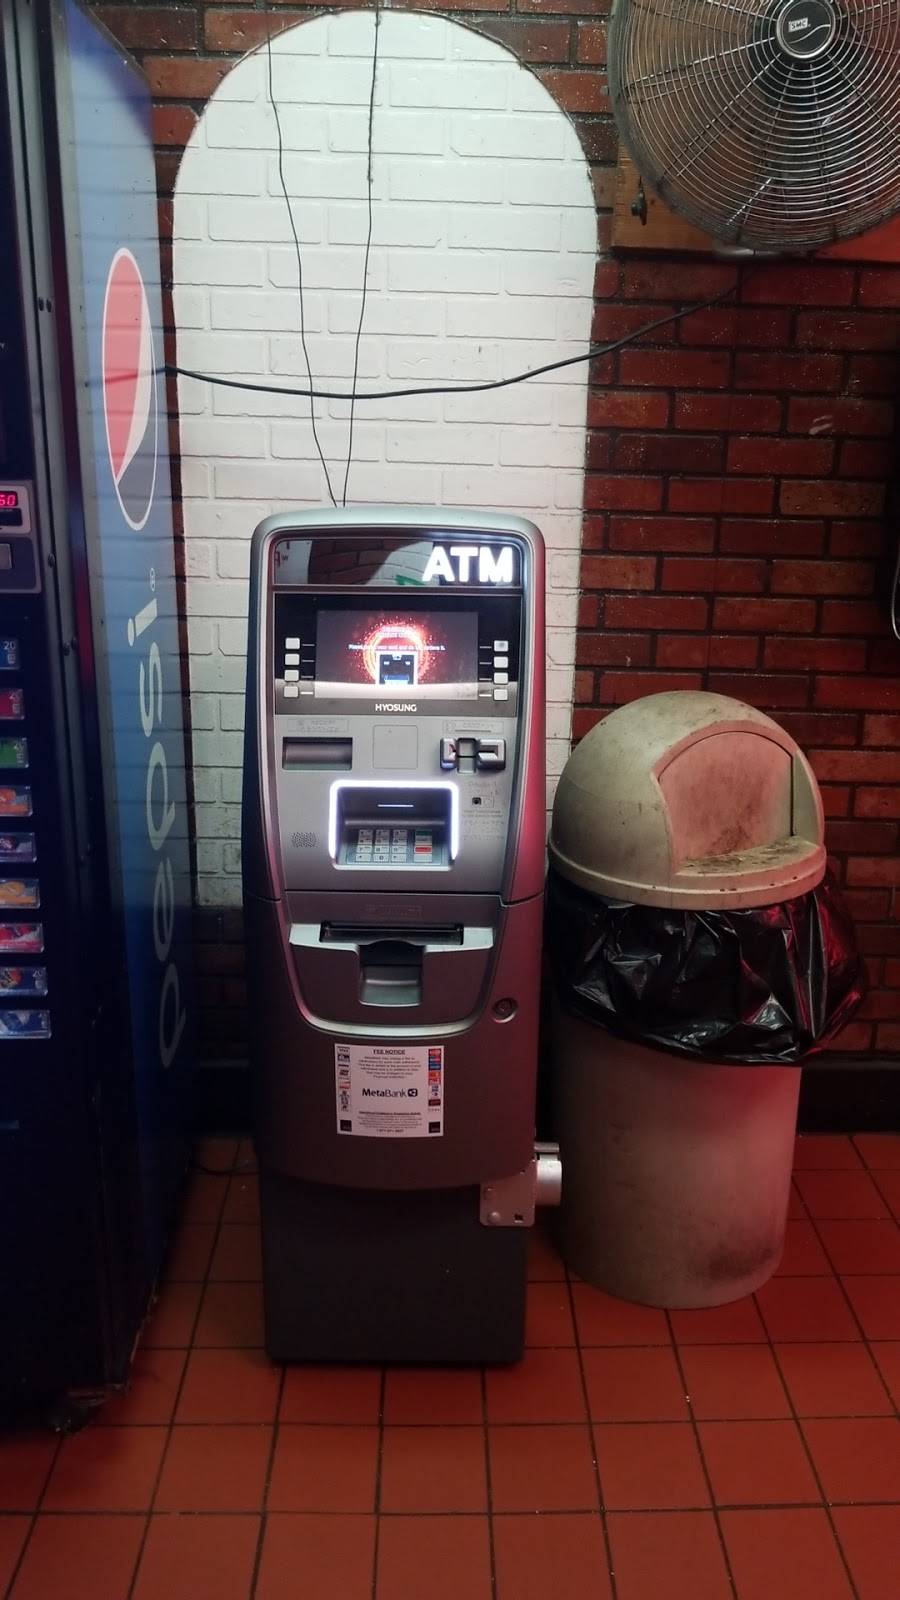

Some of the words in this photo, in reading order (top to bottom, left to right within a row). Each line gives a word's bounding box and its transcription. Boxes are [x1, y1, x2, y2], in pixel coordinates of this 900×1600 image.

[791, 19, 806, 30] SMC
[422, 545, 513, 582] ATM
[375, 703, 417, 712] HYOSUNG
[127, 597, 187, 1067] pepsi
[362, 1088, 407, 1098] MetaBank
